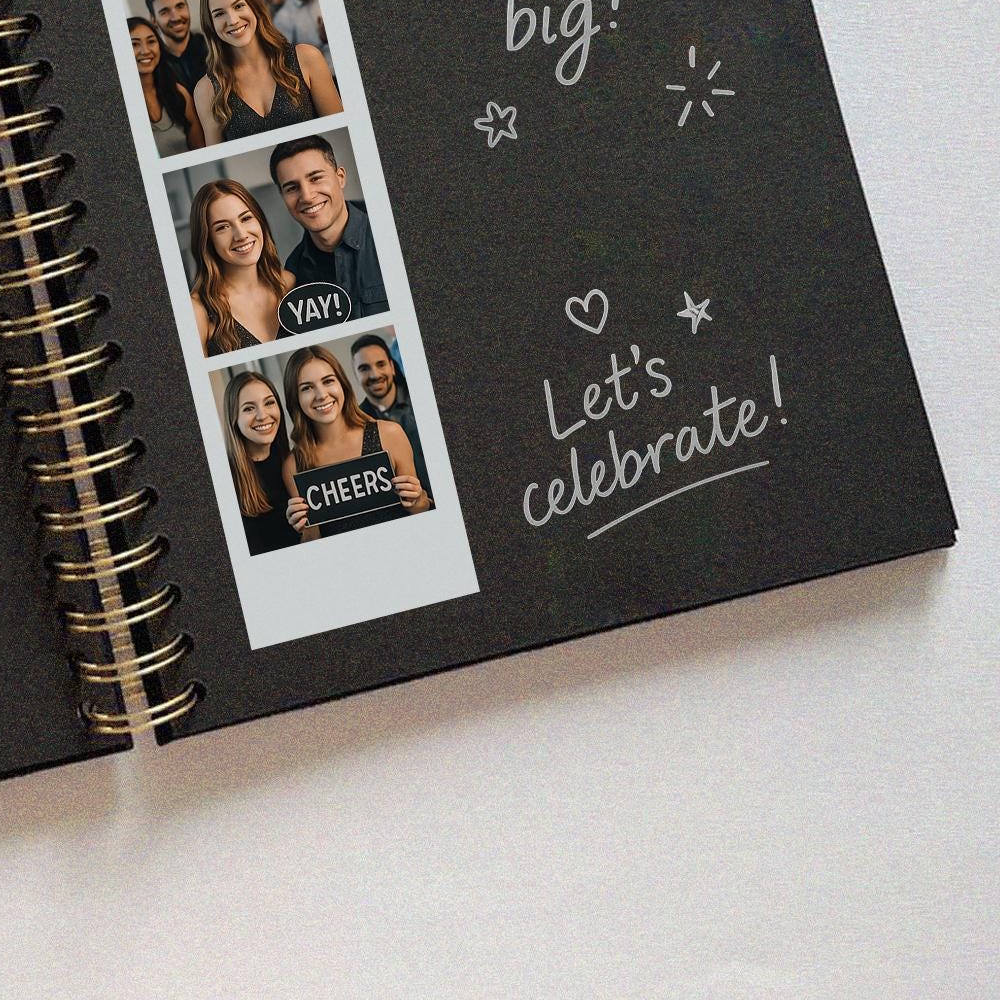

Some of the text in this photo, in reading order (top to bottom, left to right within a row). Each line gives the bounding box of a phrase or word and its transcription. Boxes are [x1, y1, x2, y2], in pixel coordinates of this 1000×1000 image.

[287, 293, 343, 325] YAY!
[543, 344, 673, 440] Let's
[523, 354, 788, 527] celebrate!
[306, 466, 392, 511] CHEERS
